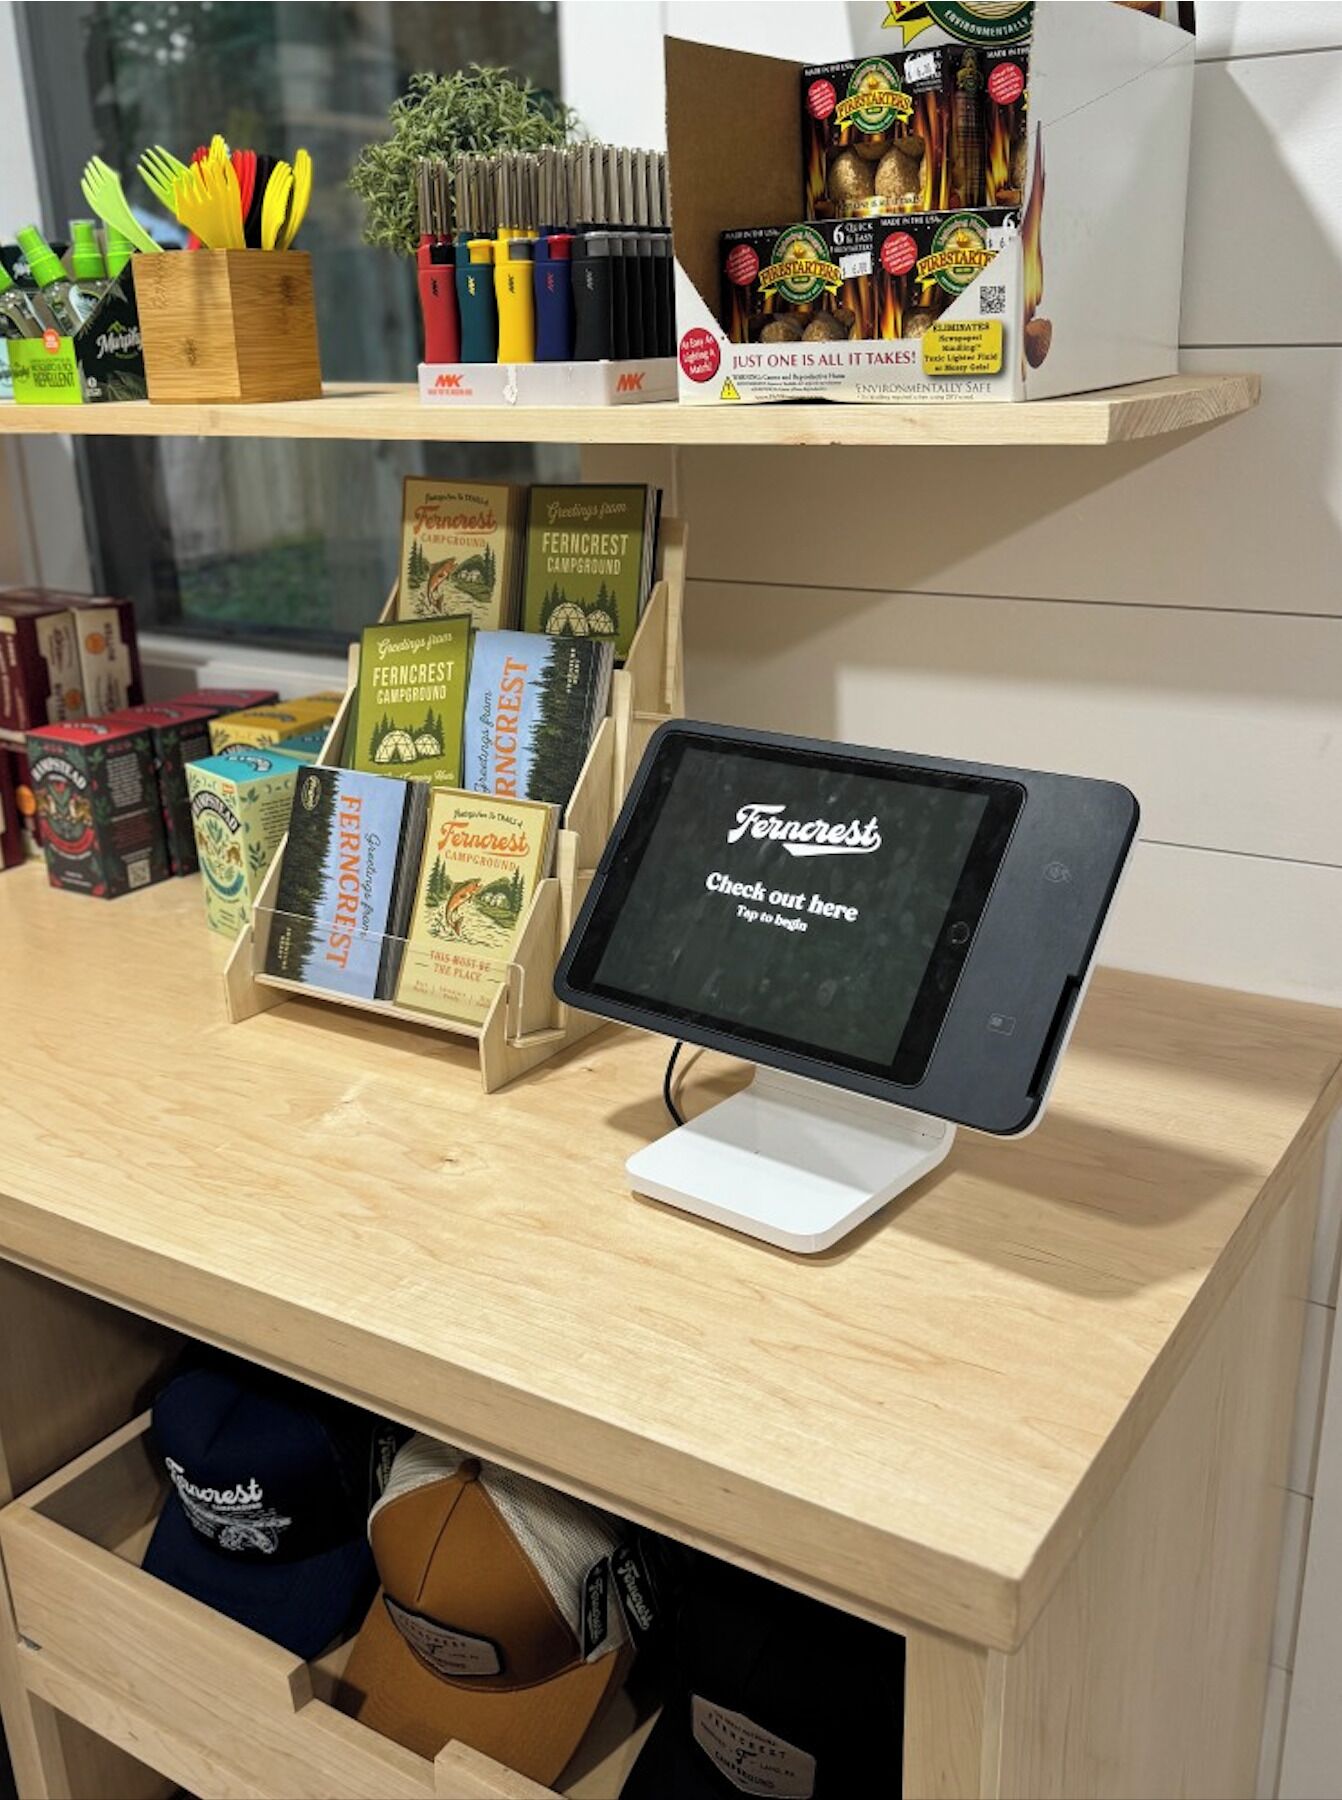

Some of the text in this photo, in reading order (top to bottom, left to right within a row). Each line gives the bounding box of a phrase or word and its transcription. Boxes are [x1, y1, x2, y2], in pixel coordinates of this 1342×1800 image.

[944, 10, 1029, 37] ENVIRONMENTALLY
[838, 91, 910, 117] FIRESTARTERS
[833, 223, 844, 245] 6
[880, 217, 900, 226] MADE
[855, 233, 873, 243] EASY
[761, 260, 841, 287] FIRESTARTERS
[933, 322, 989, 332] ELIMINATES
[733, 352, 916, 369] JUST ONE IS ALL IT TAKES!
[856, 381, 992, 393] ENVIRONMENTALLY SAFE
[413, 504, 497, 535] Ferncrest
[547, 501, 627, 524] Greetings from
[421, 532, 485, 547] CAMPGROUND
[542, 531, 629, 556] FERNCREST
[547, 557, 622, 576] CAMPGROUND
[377, 632, 453, 661] Greetings from
[373, 661, 454, 687] FERNCREST
[377, 684, 447, 705] CAMPGROUND
[479, 690, 495, 728] from
[438, 821, 530, 857] Ferncrest
[727, 803, 882, 857] Ferncrest
[445, 849, 516, 872] CAMPGROUND
[325, 794, 363, 969] FERNCREST
[360, 832, 381, 938] Greetings from
[705, 871, 859, 922] Check out here
[737, 904, 808, 932] Tap to begin
[430, 950, 491, 972] THIS MUST BE
[433, 964, 482, 982] THE PLACE
